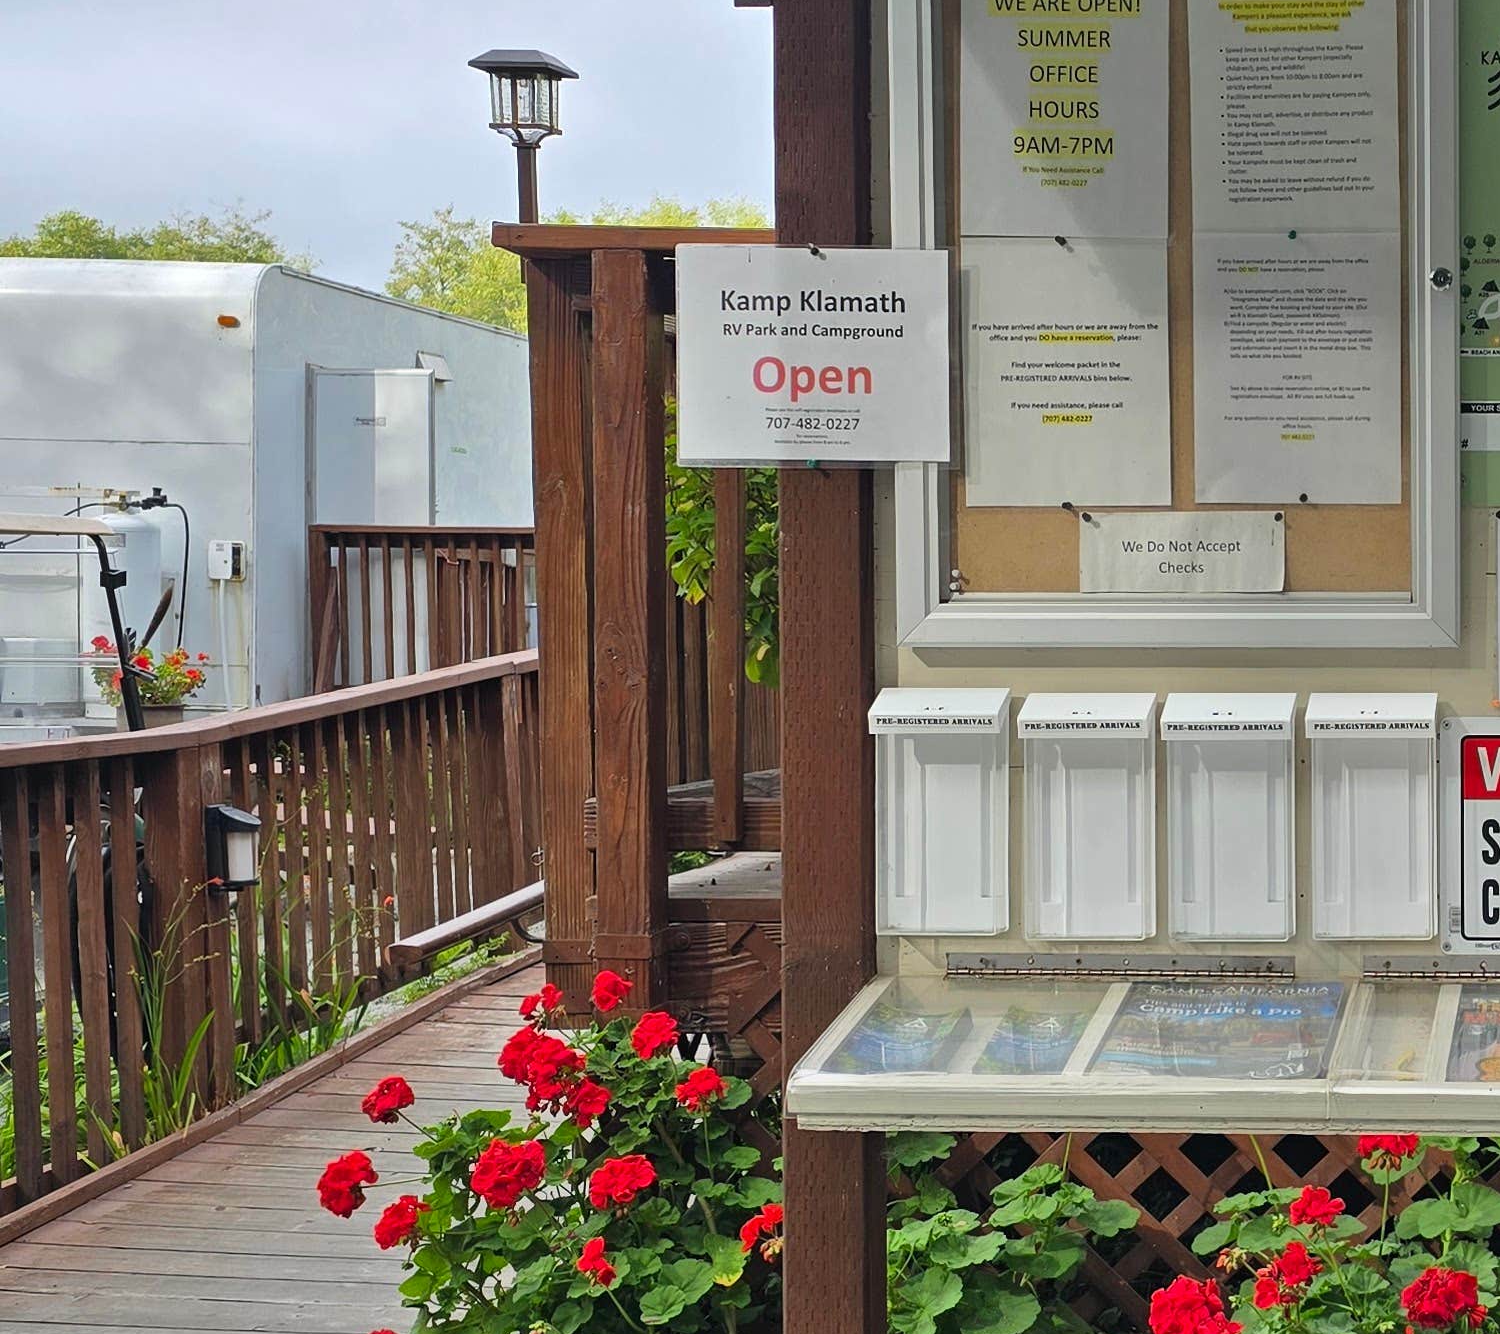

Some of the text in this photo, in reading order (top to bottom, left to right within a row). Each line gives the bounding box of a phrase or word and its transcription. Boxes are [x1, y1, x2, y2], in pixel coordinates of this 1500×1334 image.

[1018, 29, 1111, 48] SUMMER
[1030, 65, 1098, 83] OFFICE
[1030, 100, 1099, 119] HOURS
[1014, 136, 1113, 154] 9AM-7PM
[721, 290, 905, 317] Kamp Klamath
[723, 323, 903, 340] RV Park and Campground
[992, 323, 1009, 331] have
[1075, 334, 1116, 342] reservation,
[1117, 334, 1141, 342] please:
[1077, 361, 1100, 369] packet
[753, 356, 872, 403] Open
[1471, 404, 1495, 412] YOUR
[766, 417, 860, 430] 707-482-0227
[1461, 438, 1469, 448] #
[1122, 540, 1241, 554] We Do Not Accept
[1159, 561, 1204, 574] Checks
[952, 716, 992, 725] ARRIVALS
[1140, 1004, 1197, 1016] Camp
[1204, 1004, 1246, 1015] Like
[1268, 1008, 1302, 1018] Pro
